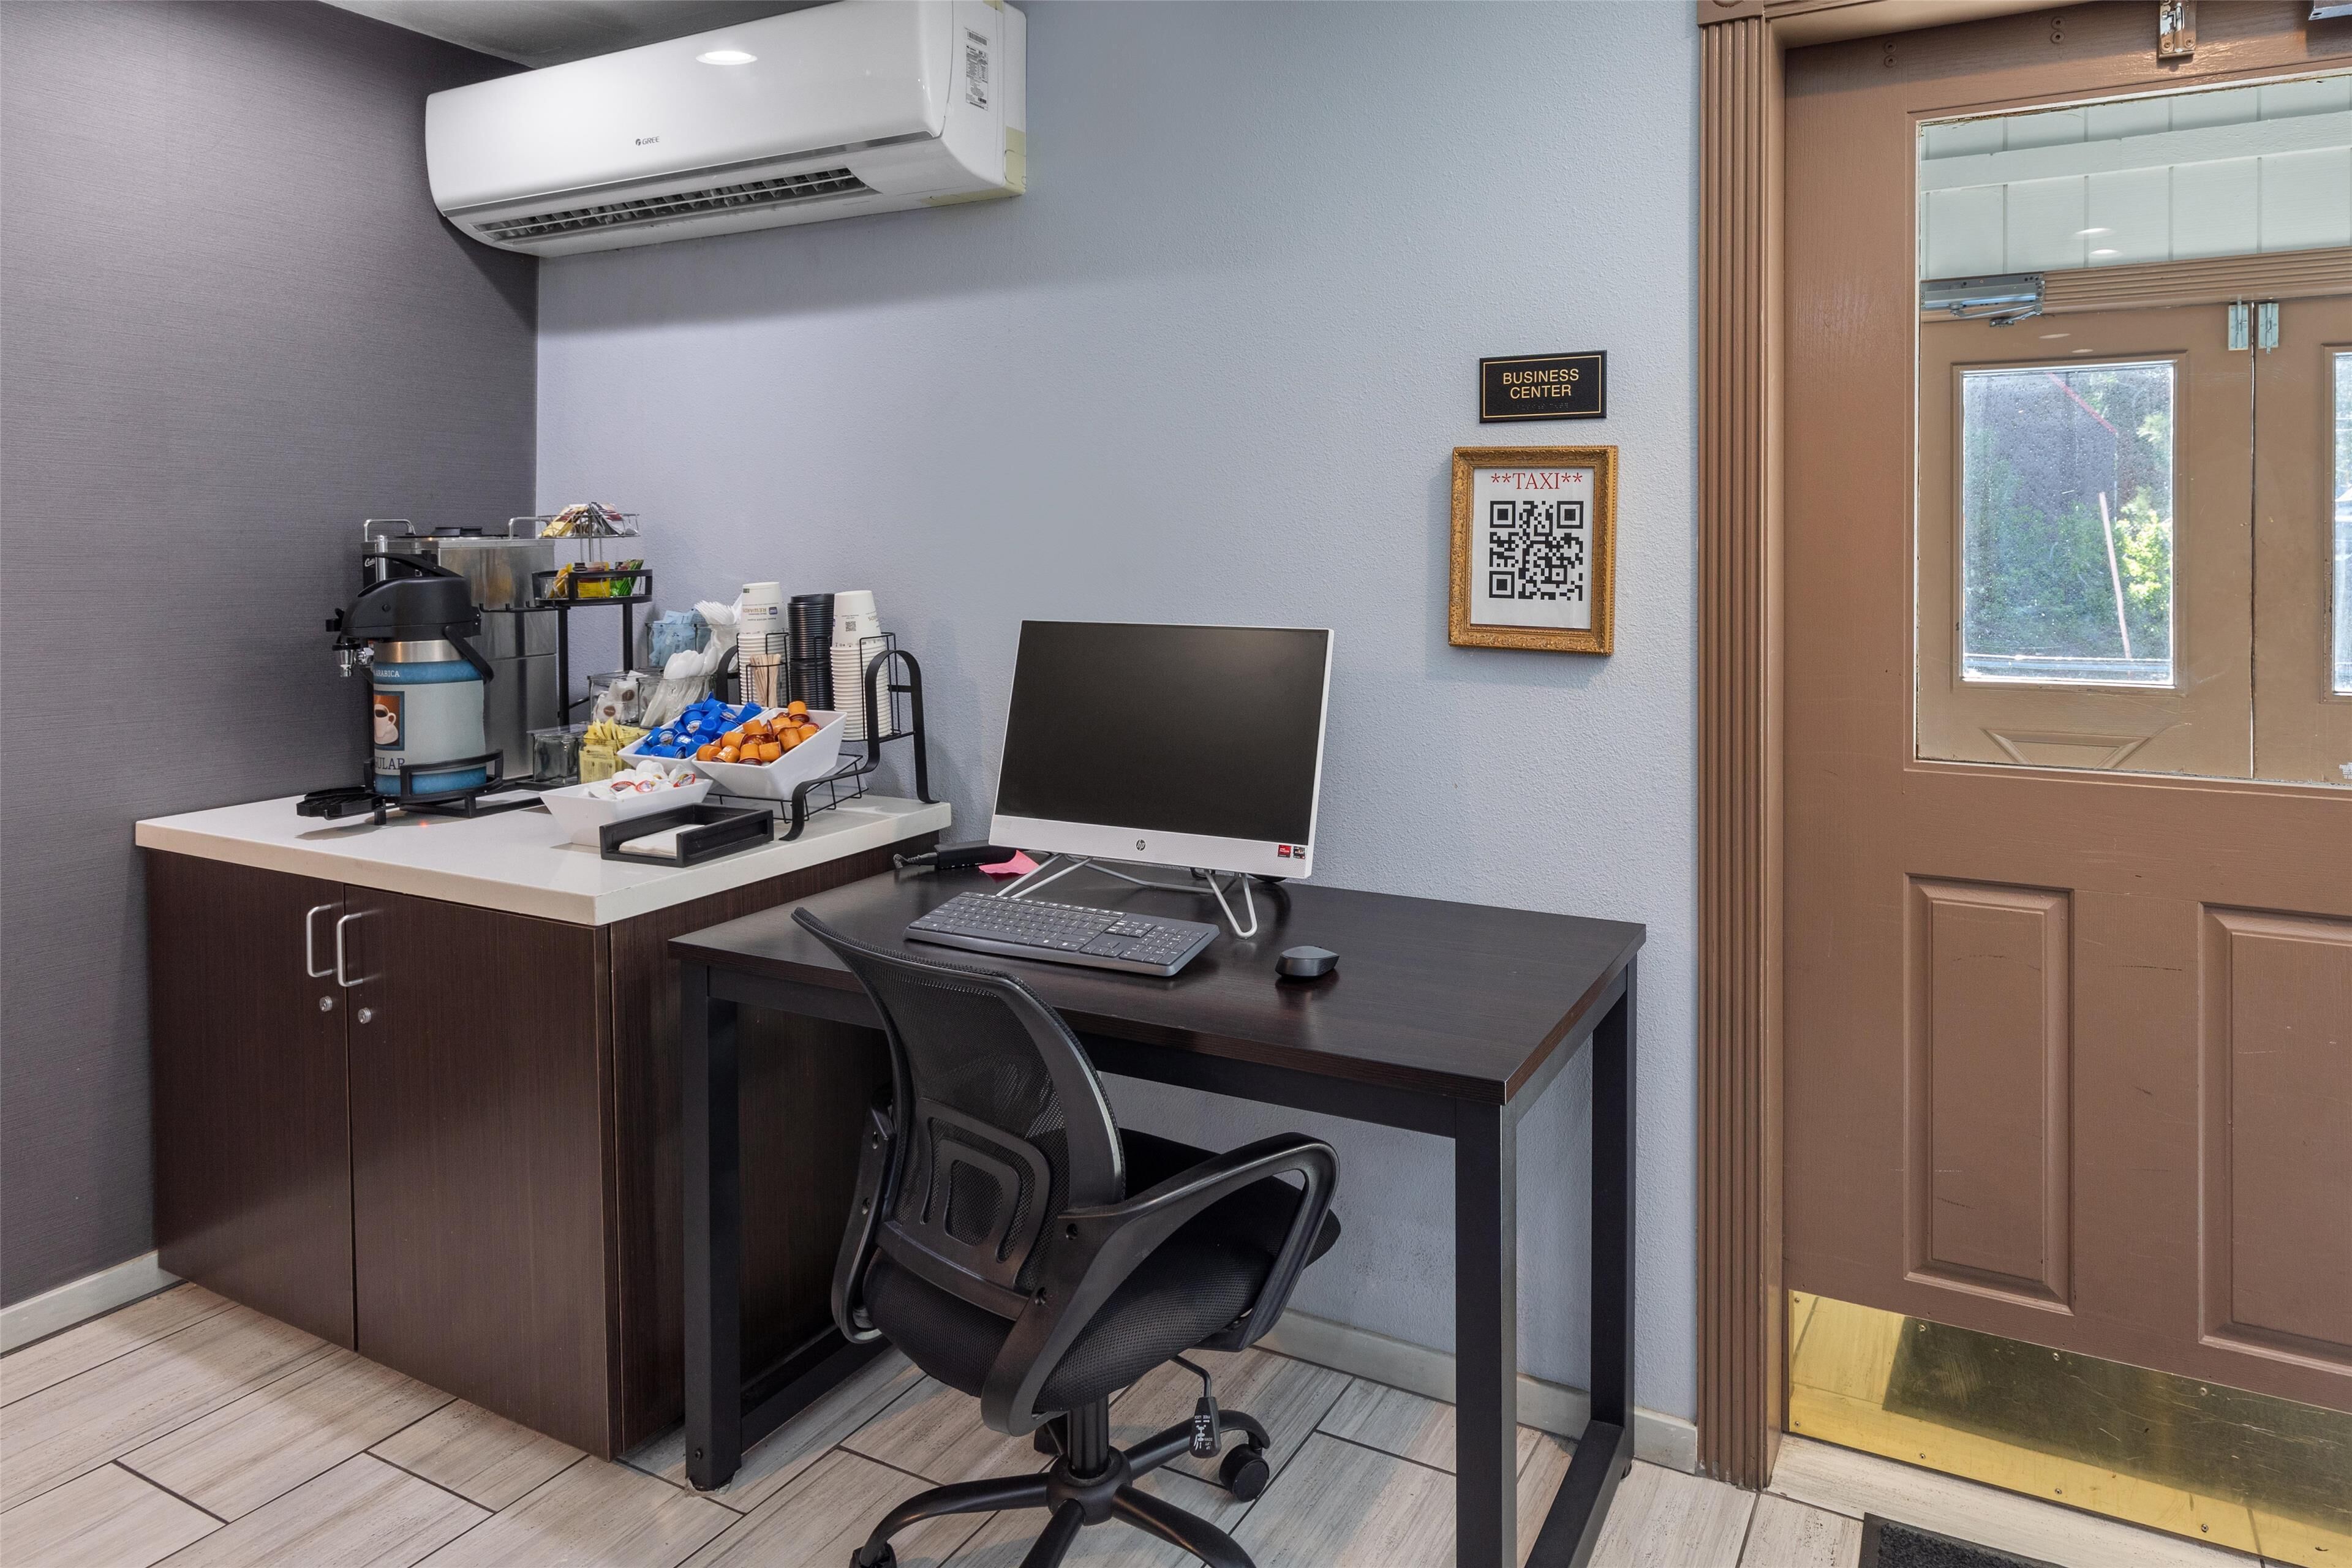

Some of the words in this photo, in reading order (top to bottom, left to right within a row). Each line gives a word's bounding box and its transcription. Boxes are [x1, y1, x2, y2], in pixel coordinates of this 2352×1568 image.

[642, 136, 660, 145] GREE
[1503, 369, 1579, 385] BUSINESS
[1510, 385, 1572, 399] CENTER
[375, 756, 405, 770] ULAR
[1136, 840, 1145, 851] hp
